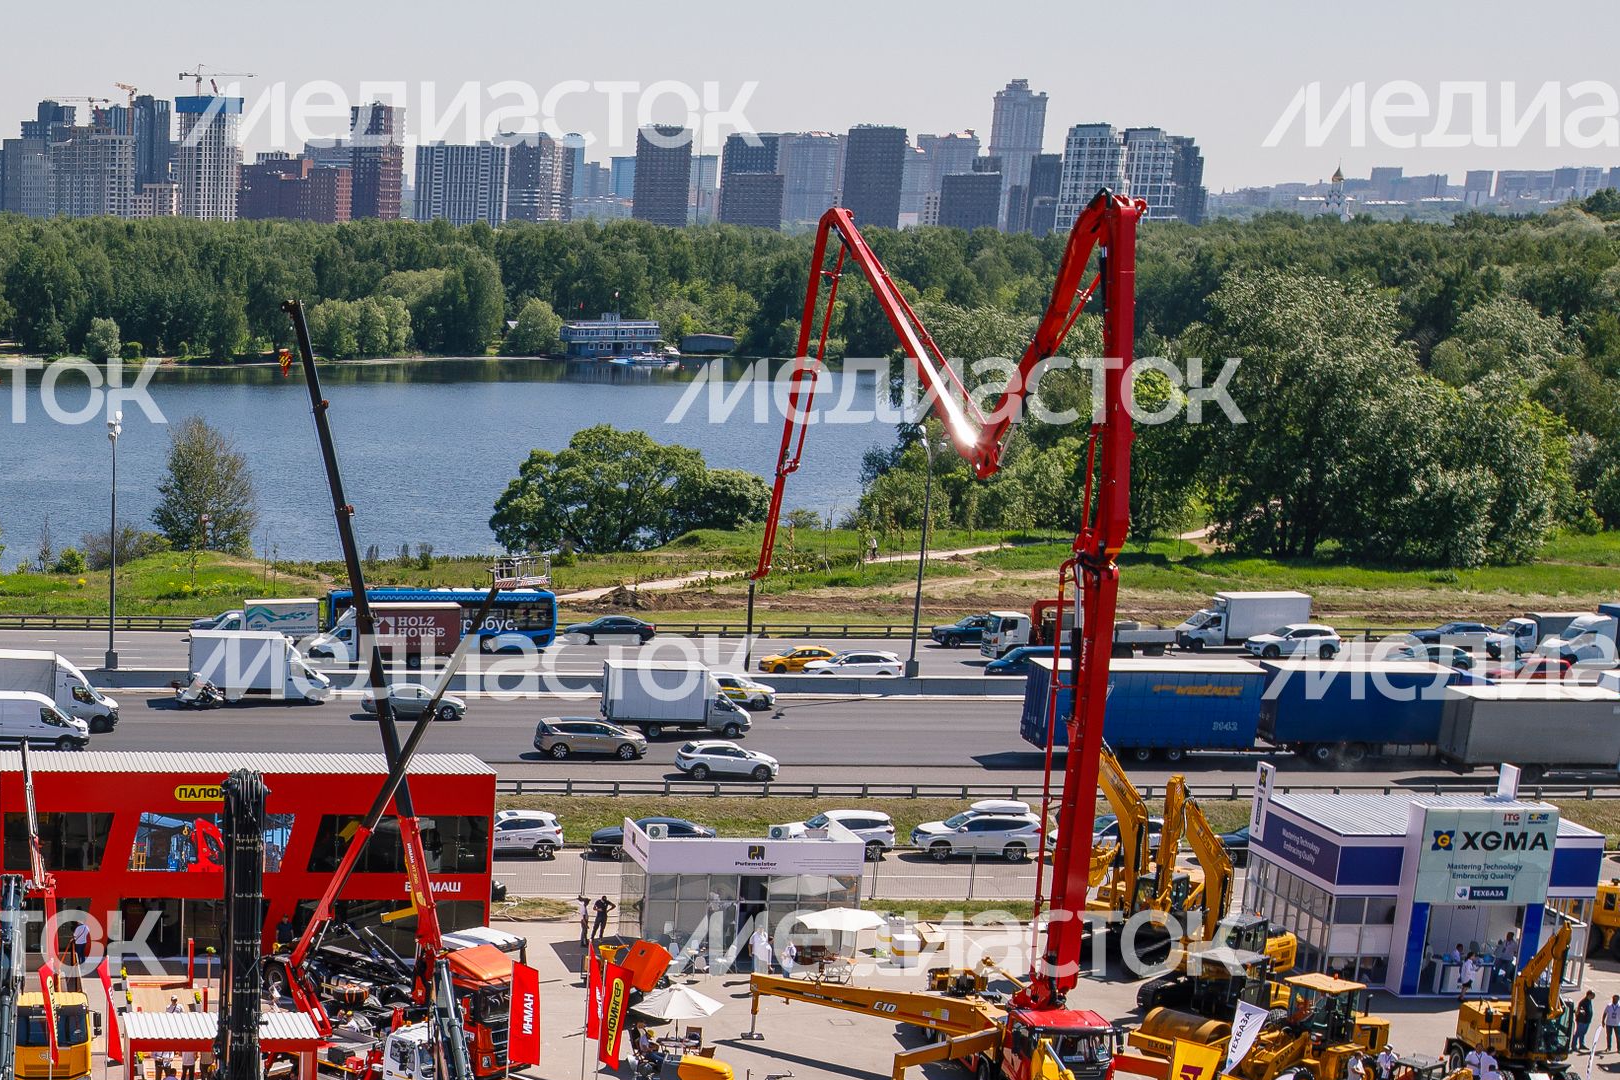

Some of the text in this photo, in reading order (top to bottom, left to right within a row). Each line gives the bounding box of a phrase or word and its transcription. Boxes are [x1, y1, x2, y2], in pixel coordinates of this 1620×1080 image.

[397, 616, 435, 627] HOLZ
[397, 627, 446, 638] HOUSE
[1460, 831, 1549, 851] XGMA
[1447, 863, 1523, 872] Mastering Technology
[1452, 872, 1515, 881] Embracing Quality
[523, 993, 534, 1035] ИНМАН
[1230, 1011, 1253, 1054] ТЕХБАЗА
